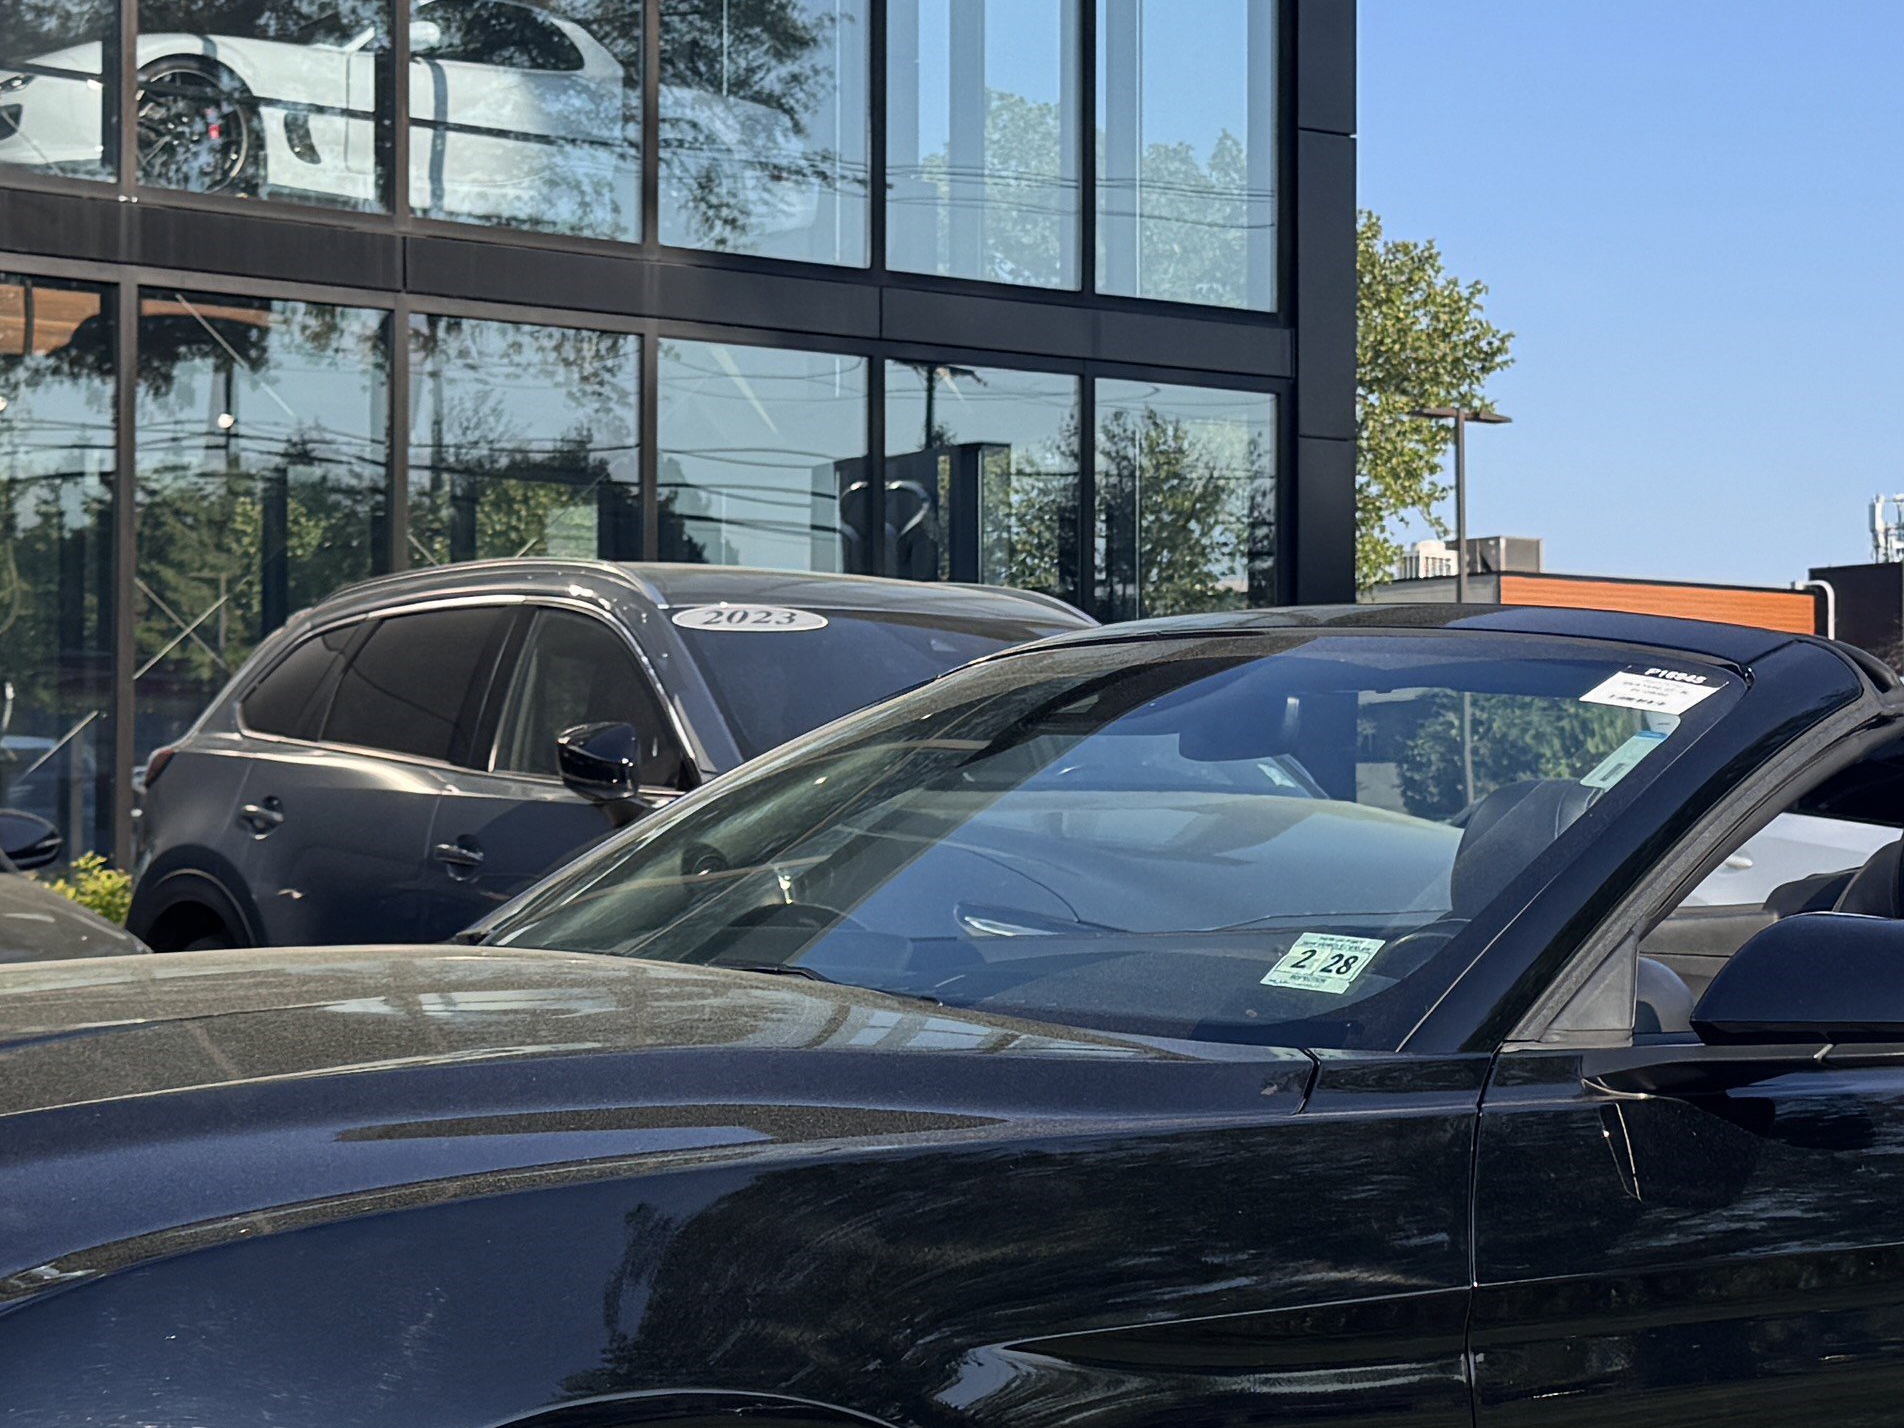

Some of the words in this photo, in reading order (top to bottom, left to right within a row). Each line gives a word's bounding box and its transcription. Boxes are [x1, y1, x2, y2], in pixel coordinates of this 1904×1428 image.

[702, 610, 796, 625] 2023
[1290, 949, 1317, 969] 2
[1319, 953, 1359, 974] 28
